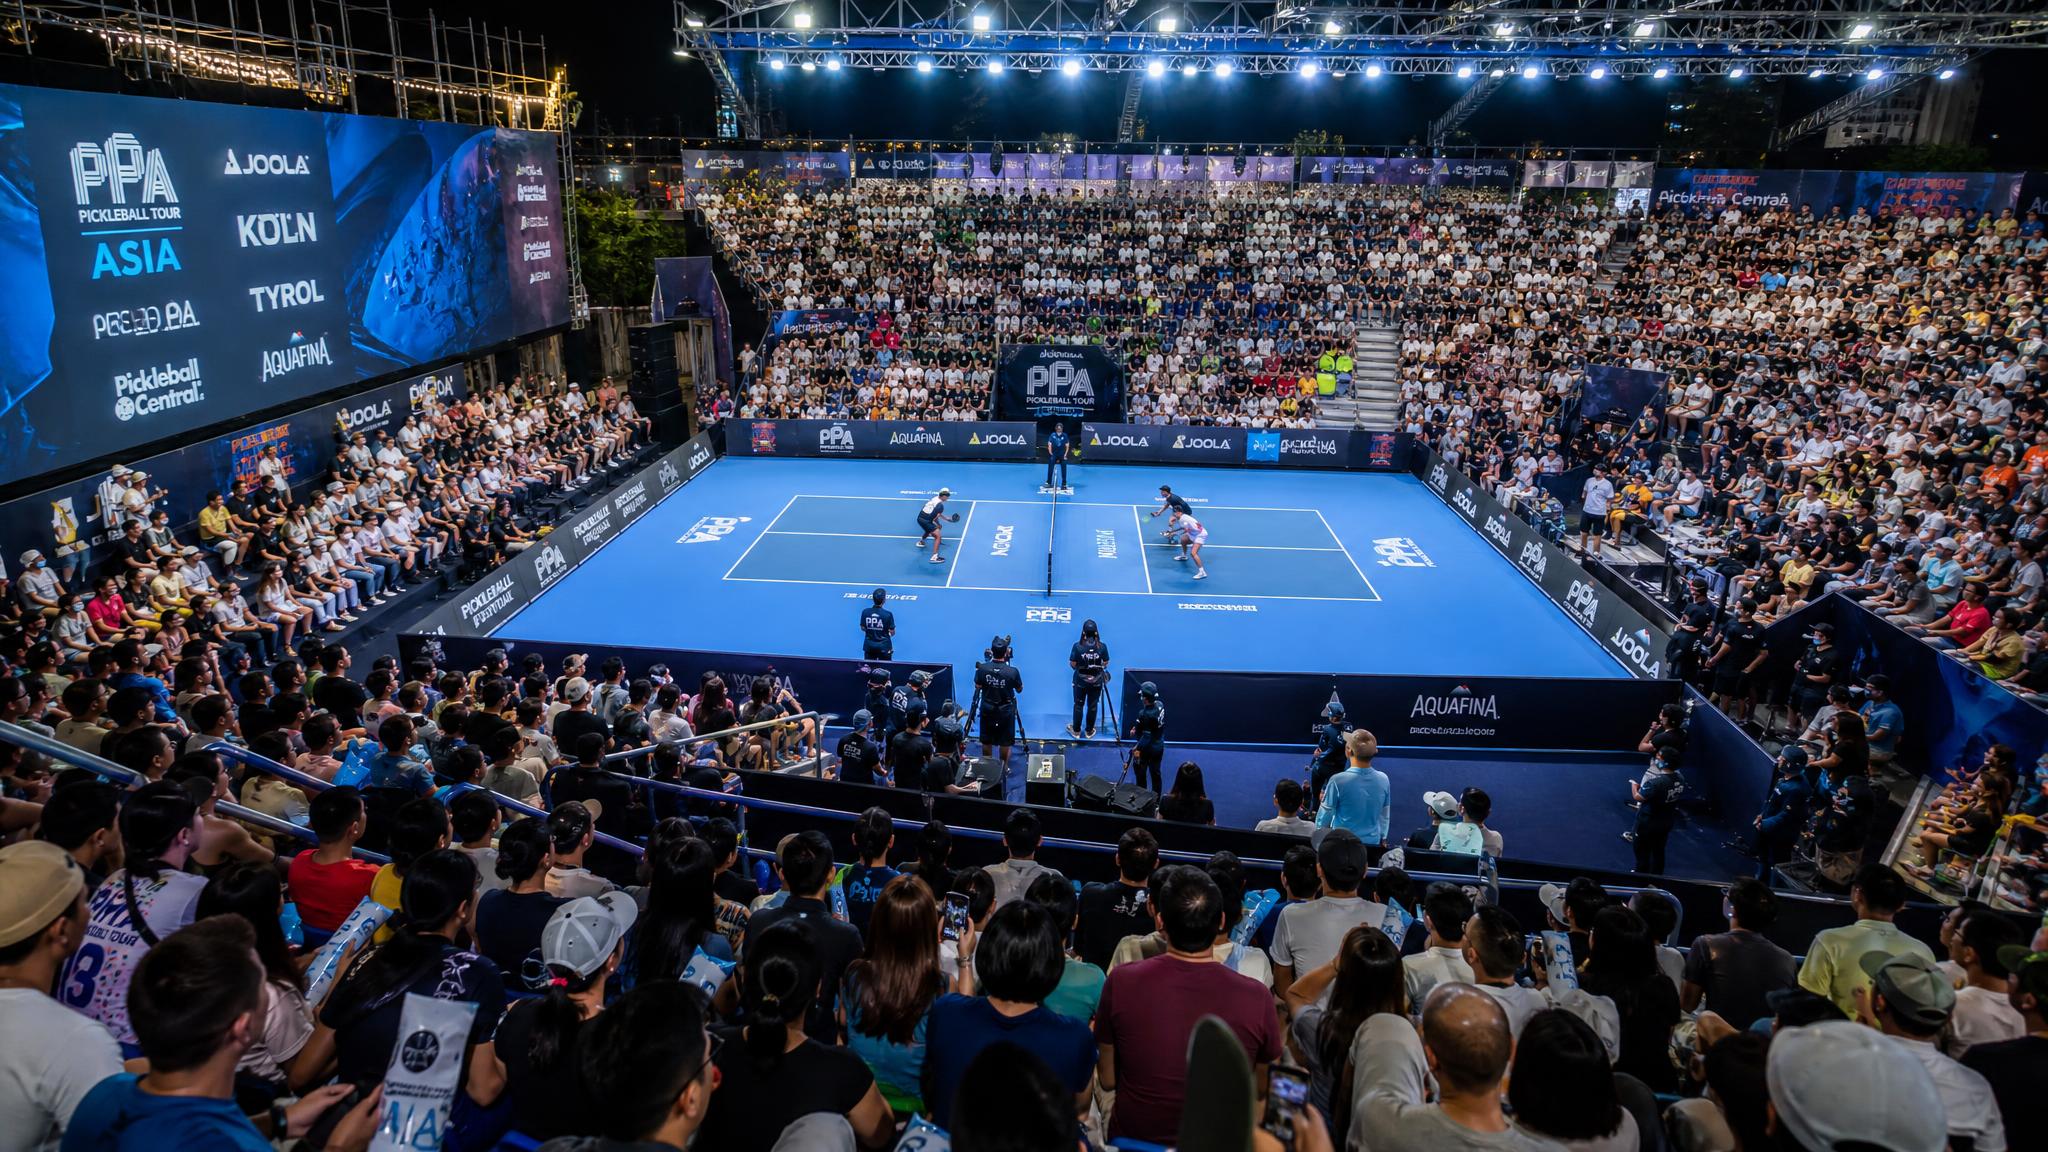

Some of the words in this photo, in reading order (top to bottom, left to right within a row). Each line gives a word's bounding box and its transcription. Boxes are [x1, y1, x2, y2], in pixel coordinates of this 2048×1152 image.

[69, 132, 179, 205] PPA
[242, 154, 310, 175] JOOLA
[78, 208, 149, 223] PICKLEBALL
[150, 206, 182, 220] TOUR
[92, 238, 182, 279] ASIA
[249, 279, 325, 312] TYROL
[262, 336, 334, 382] AQUAFINA
[114, 358, 200, 398] Pickleball
[1026, 361, 1095, 396] PPA
[134, 381, 200, 416] Central
[1073, 397, 1095, 405] TOUR
[819, 426, 854, 445] PPA
[889, 431, 945, 446] AQUAFINA
[981, 434, 1027, 445] JOOLA
[1103, 435, 1149, 447] JOOLA
[1185, 438, 1231, 450] JOOLA
[534, 545, 566, 581] PPA
[1520, 541, 1547, 582] PPA
[1566, 579, 1599, 623] PPA
[1614, 627, 1660, 679] JOOLA
[1410, 694, 1500, 720] AQUAFINA
